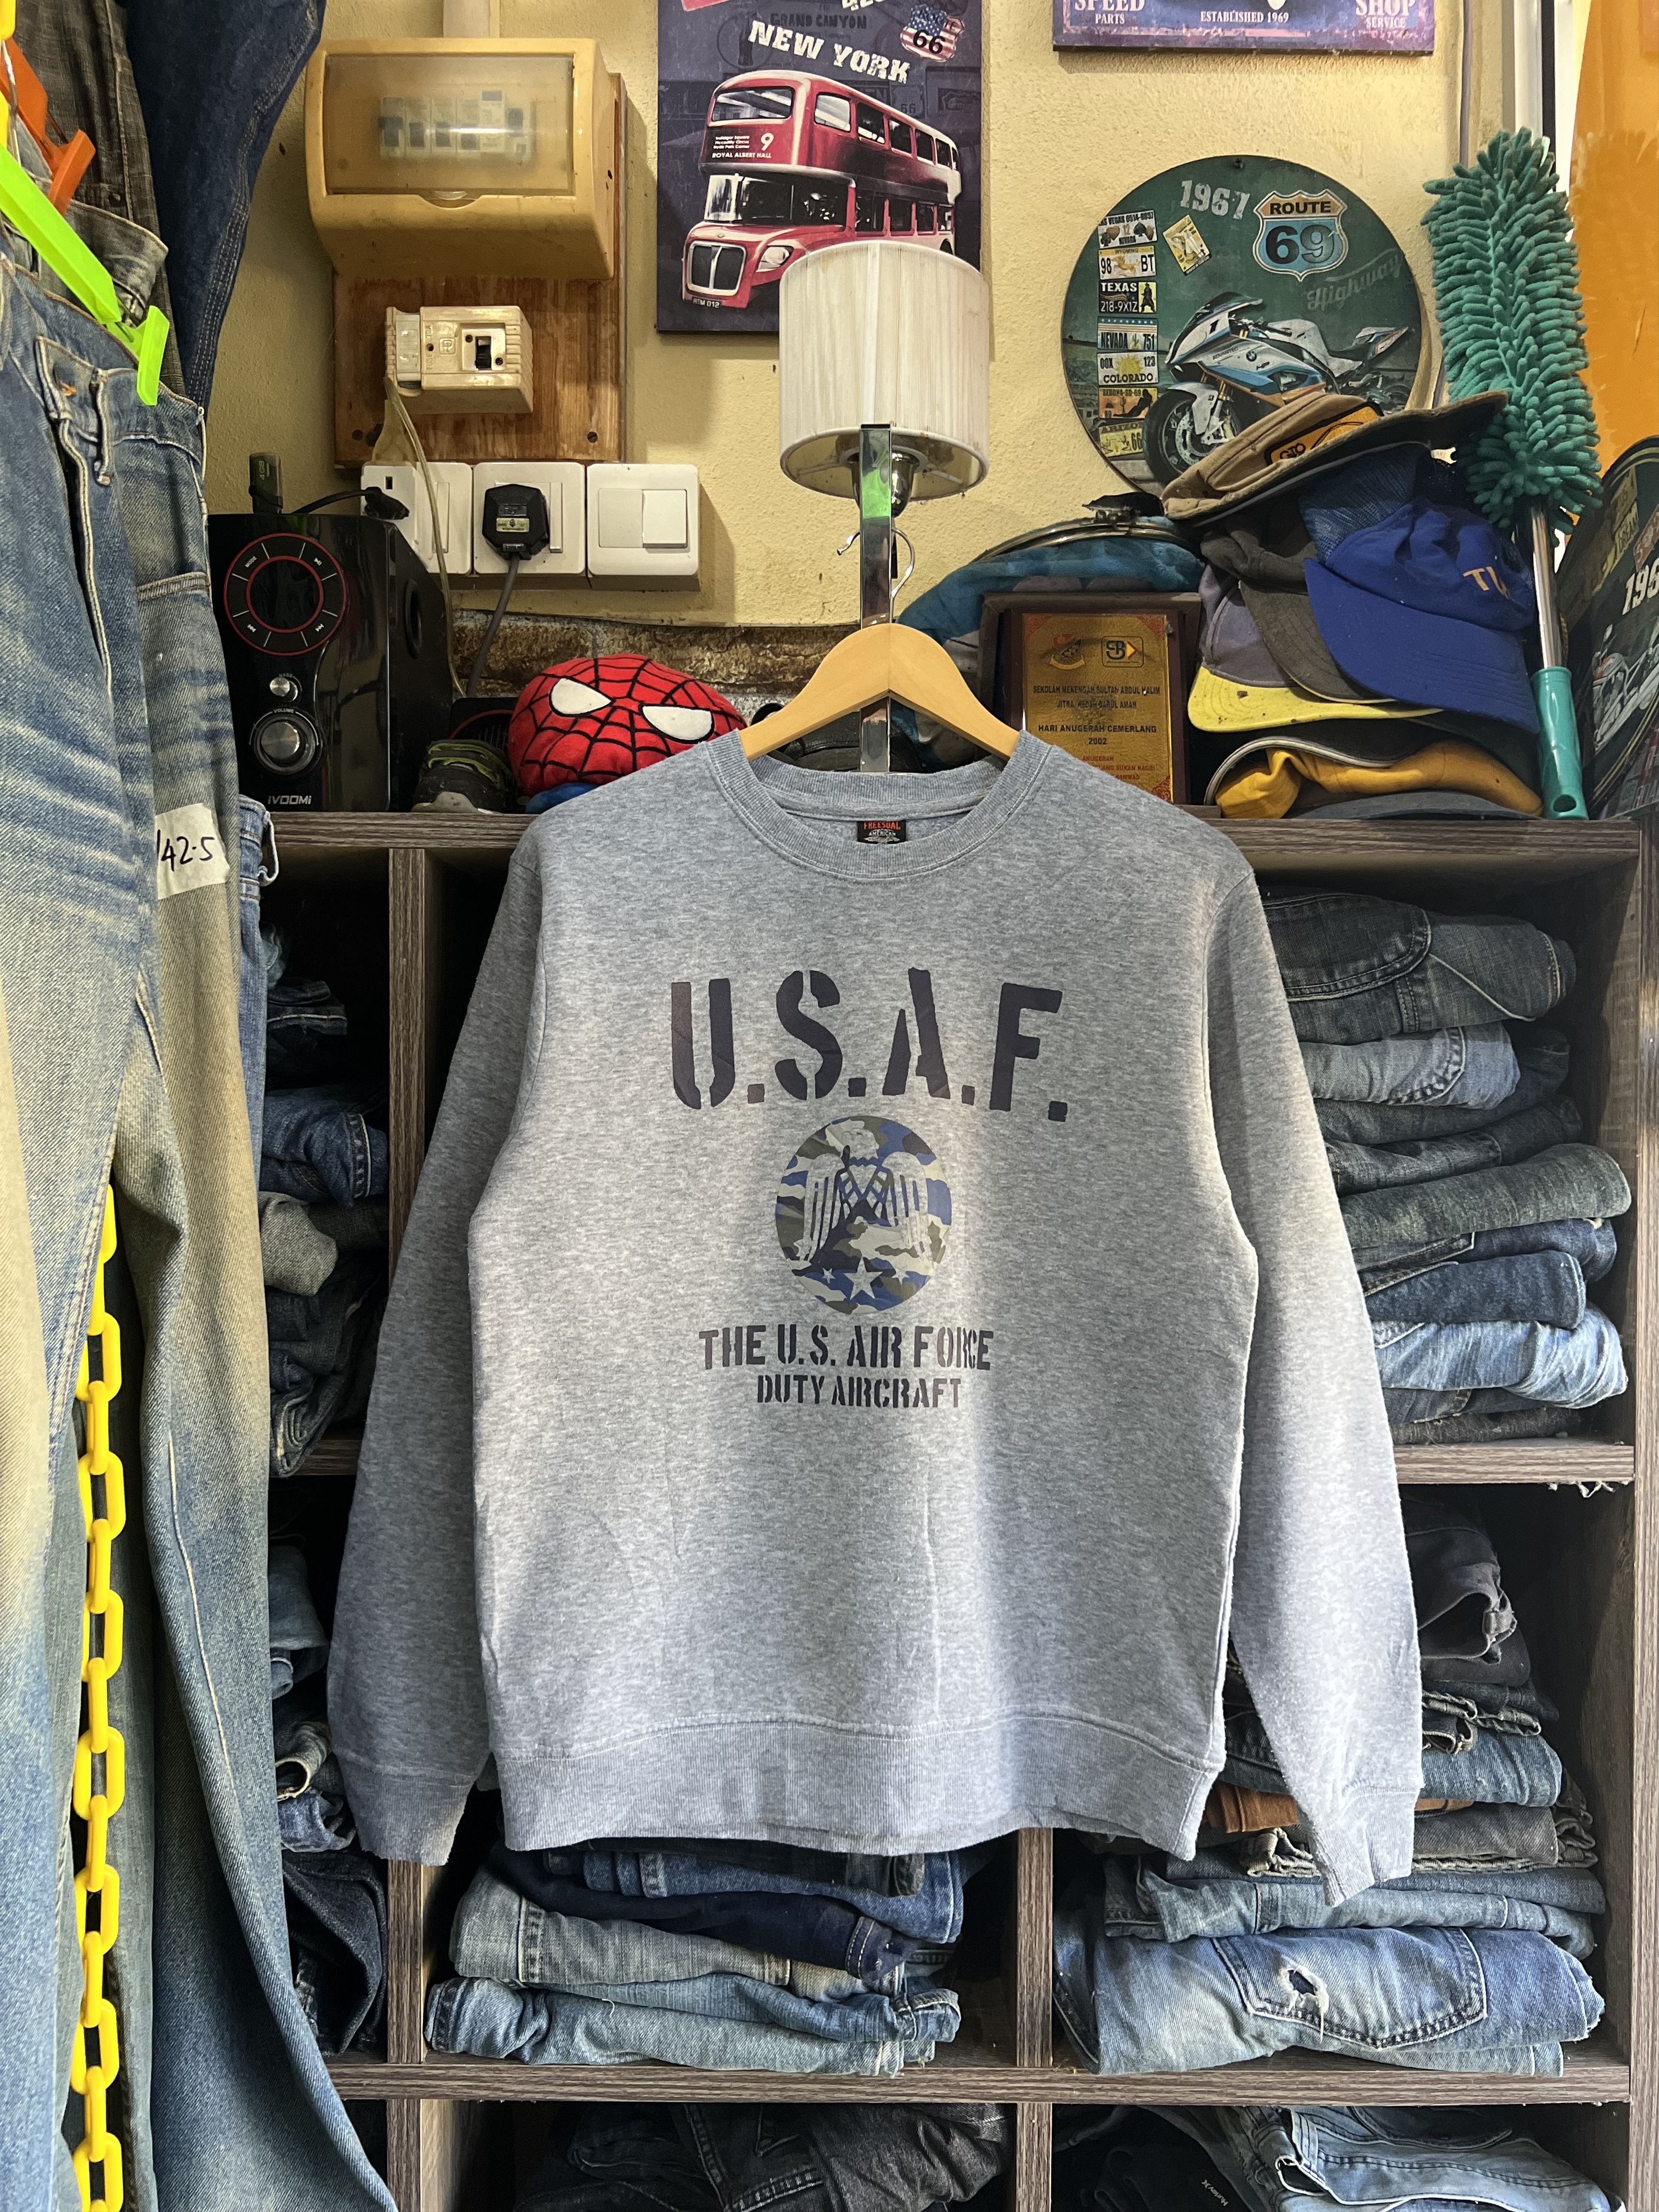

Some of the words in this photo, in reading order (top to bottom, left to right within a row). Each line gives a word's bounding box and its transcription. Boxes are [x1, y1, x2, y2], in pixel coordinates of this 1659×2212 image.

[1095, 14, 1125, 24] PARTS
[1201, 11, 1264, 23] ESTABLISHED
[1267, 12, 1289, 23] 1969
[1366, 17, 1406, 29] SERVICE
[913, 29, 946, 54] 66
[748, 20, 825, 60] NEW
[833, 43, 910, 84] YORK
[760, 132, 775, 151] 9
[1180, 180, 1250, 220] 1967
[1270, 201, 1331, 215] ROUTE
[1266, 224, 1335, 264] 69
[1101, 258, 1112, 274] 98
[1141, 254, 1154, 272] BT
[1101, 282, 1138, 292] TEXAS
[1306, 253, 1403, 312] Highway
[706, 300, 720, 308] 012
[1209, 319, 1220, 334] 1
[1101, 332, 1128, 349] NEVADA
[1143, 333, 1155, 351] 751
[1143, 356, 1156, 367] 123
[1103, 373, 1153, 383] COLORADO
[1131, 432, 1142, 450] 66
[1279, 443, 1306, 460] GTO
[245, 555, 258, 568] MODE
[1033, 685, 1060, 694] SEKOLAH
[1120, 686, 1140, 694] ABDUL
[1120, 701, 1137, 709] AMAN
[1107, 725, 1157, 733] CEMERLANG
[670, 967, 1068, 1122] U.S.A.F.
[699, 1325, 766, 1371] THE
[777, 1324, 836, 1366] U.S.
[847, 1325, 902, 1368] AIR
[913, 1325, 994, 1371] FORCE
[757, 1374, 824, 1404] DUTY
[831, 1376, 961, 1409] AIRCRAFT
